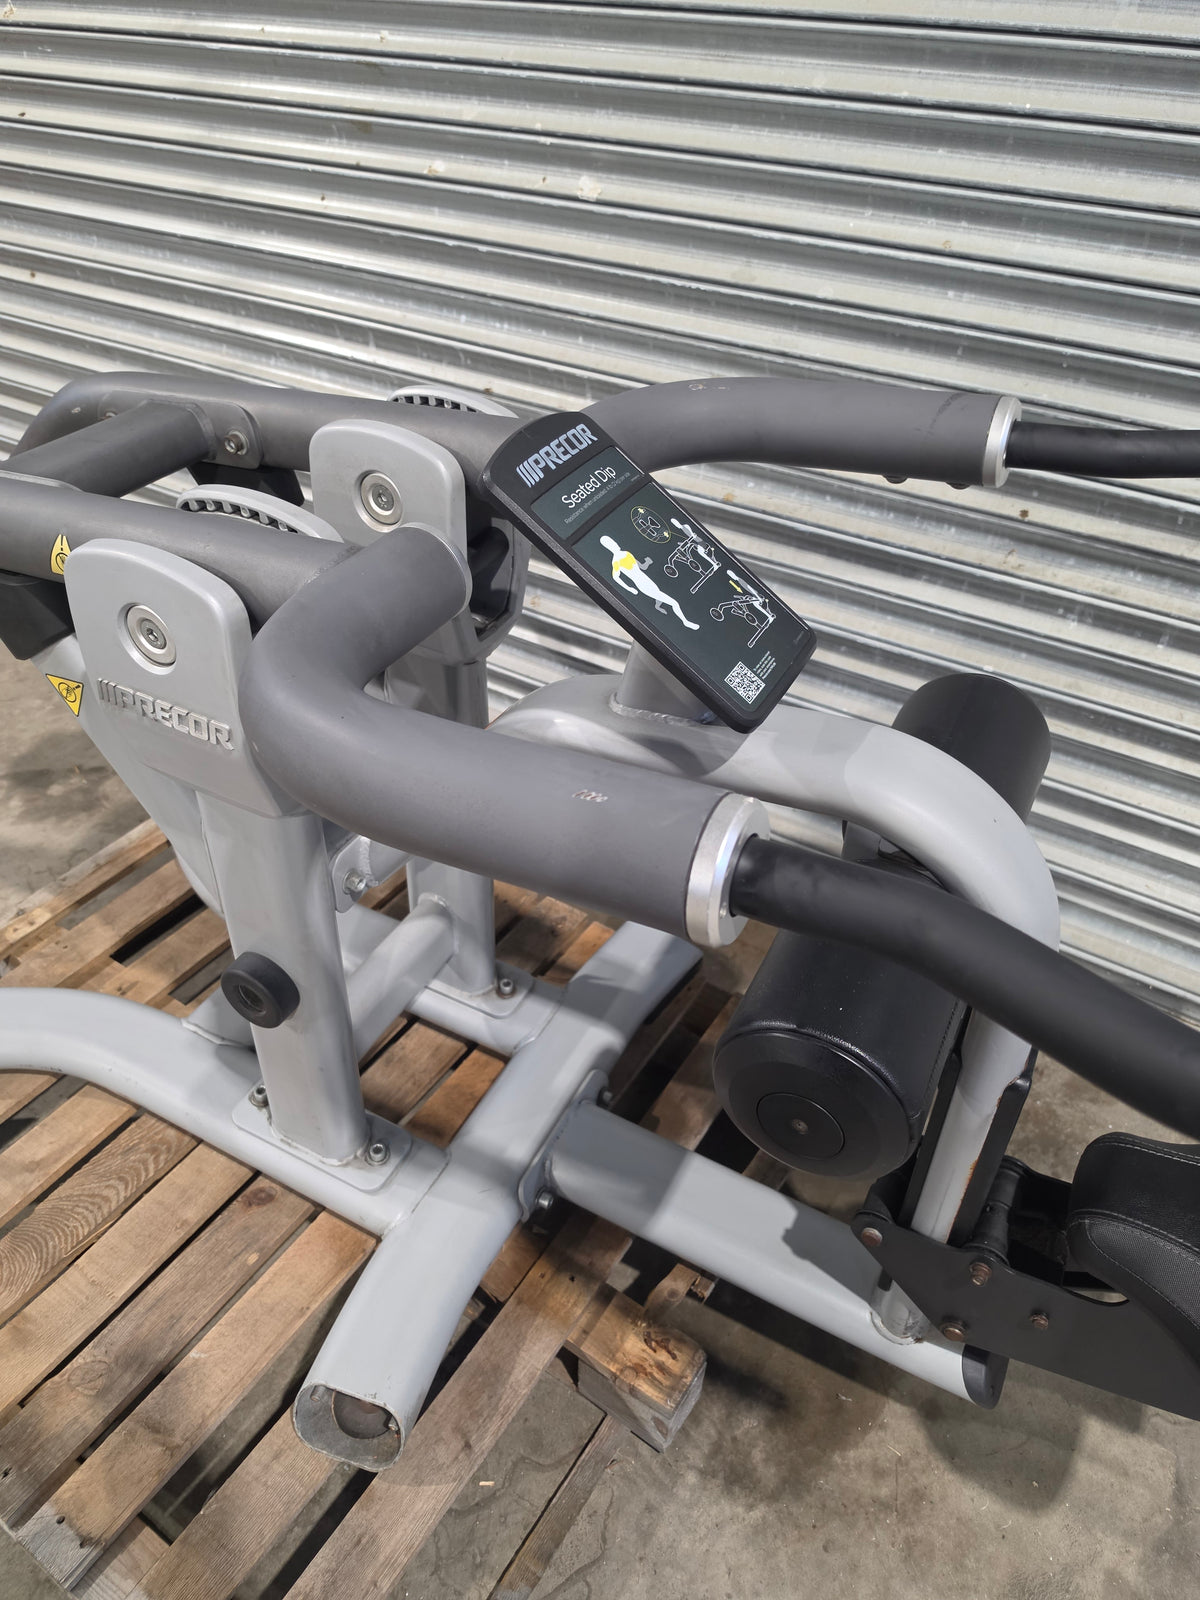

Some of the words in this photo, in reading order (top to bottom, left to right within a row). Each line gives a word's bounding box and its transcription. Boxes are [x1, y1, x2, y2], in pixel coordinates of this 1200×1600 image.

[526, 423, 598, 480] PRECOR
[561, 474, 601, 509] Seated
[594, 466, 616, 483] Dip
[114, 684, 235, 750] PRECOR
